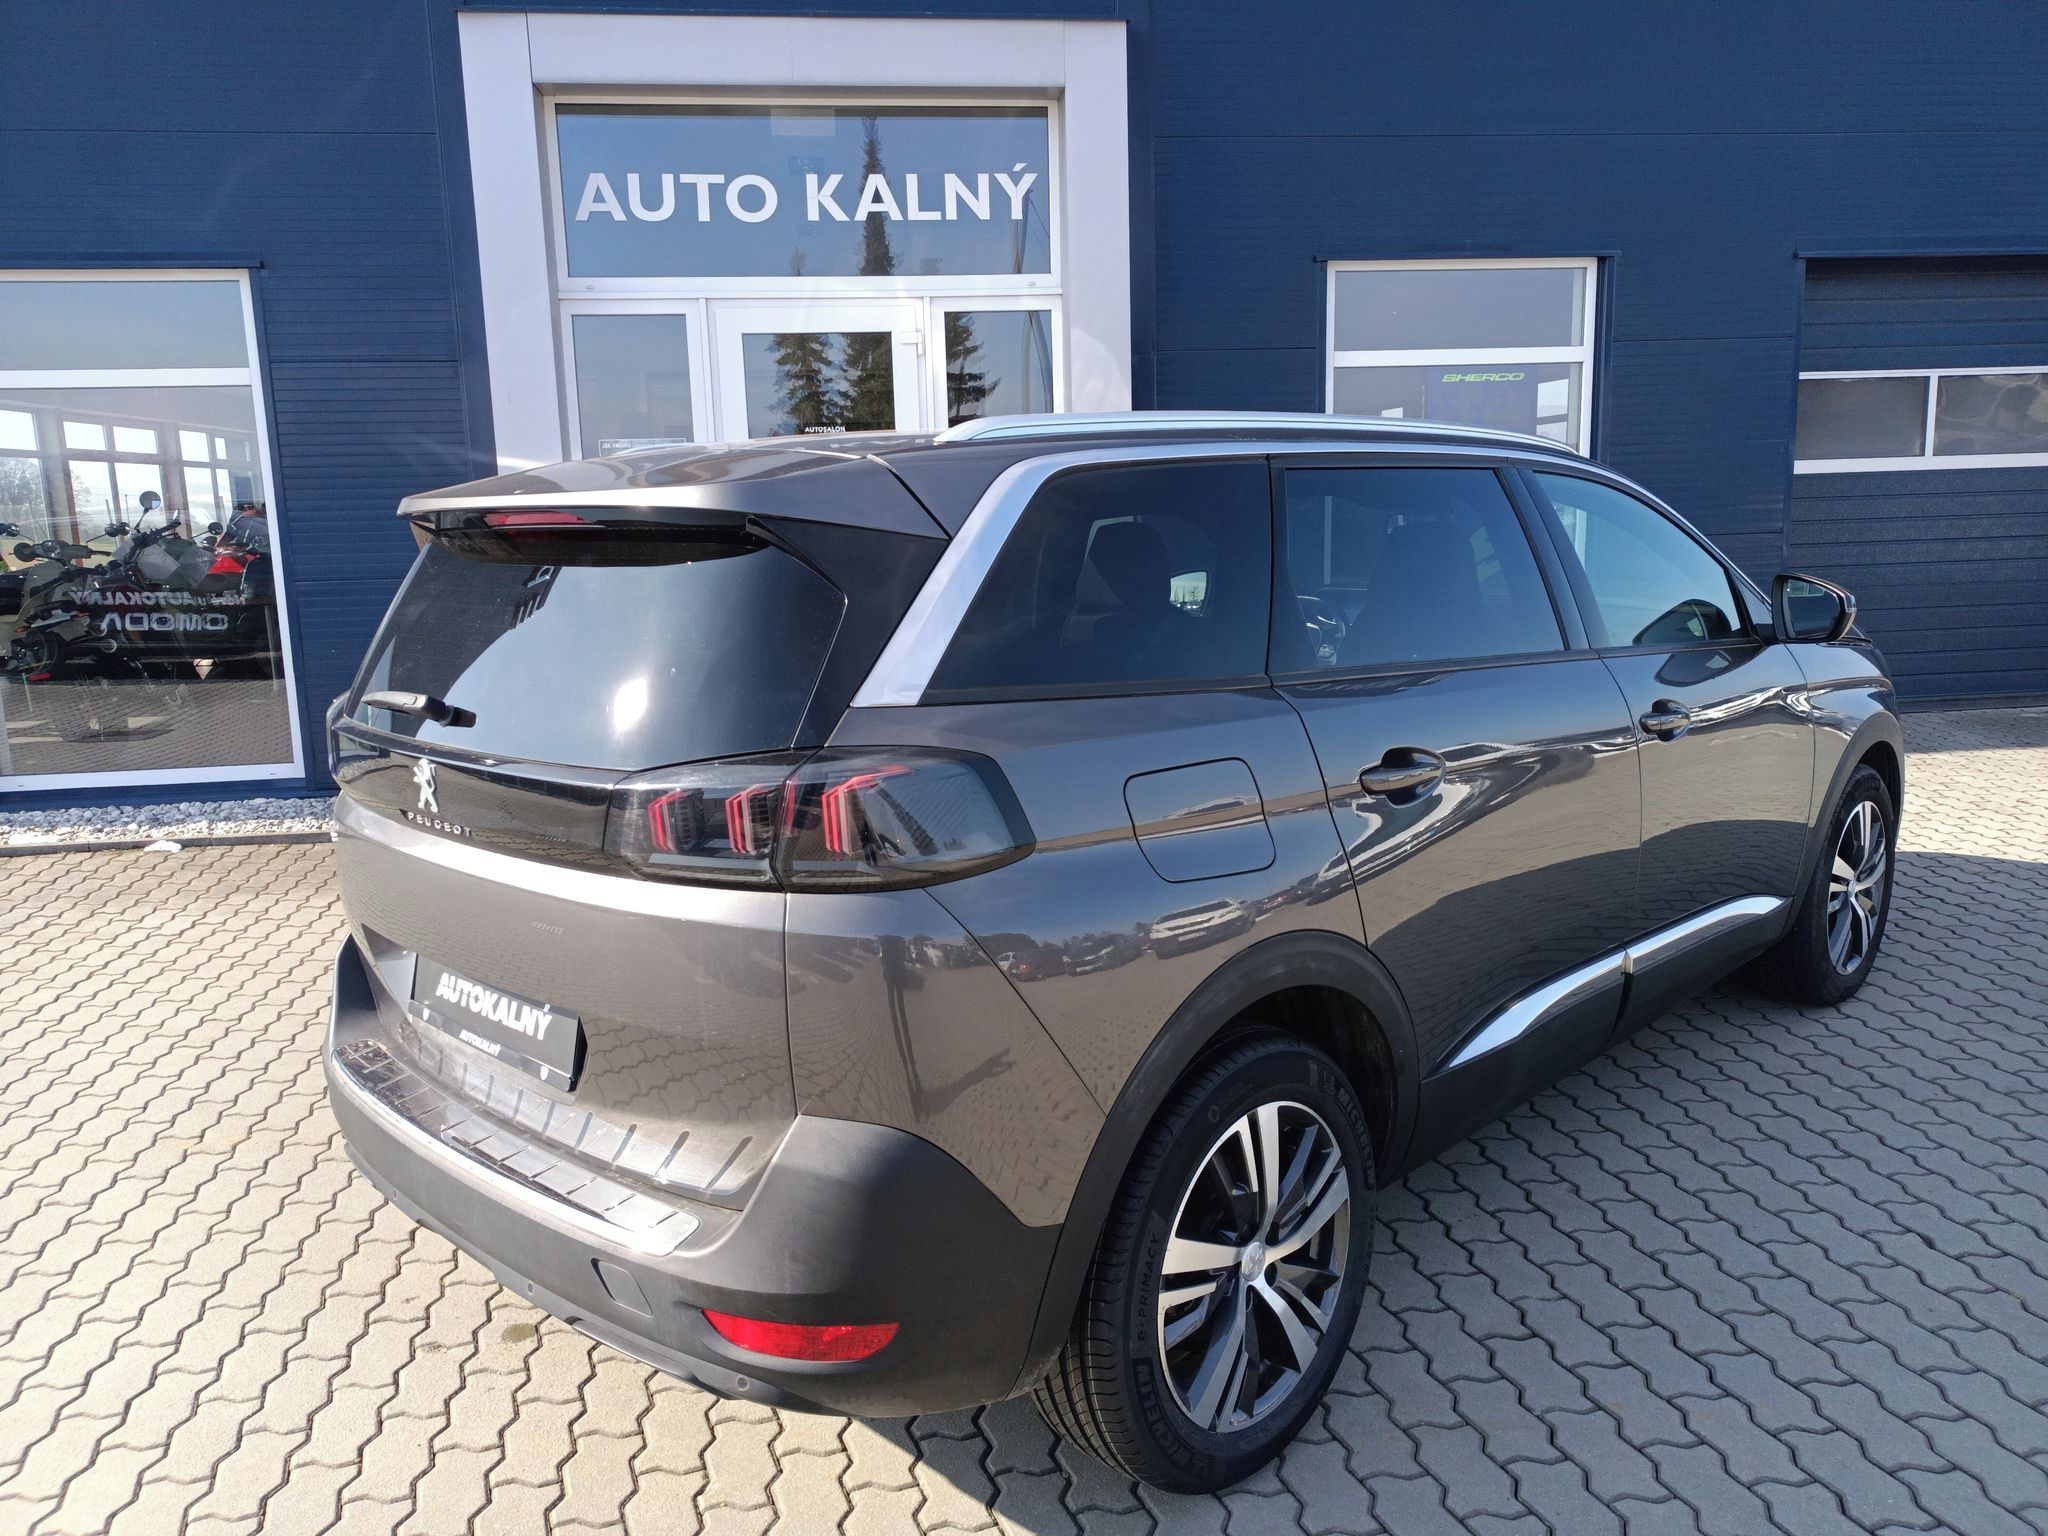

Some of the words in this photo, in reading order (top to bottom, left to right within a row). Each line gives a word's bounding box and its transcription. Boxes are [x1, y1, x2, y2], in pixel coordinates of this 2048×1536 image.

[575, 173, 778, 223] AUTO
[806, 162, 1038, 222] KALNÝ
[1441, 372, 1526, 383] SHERCO
[804, 425, 846, 433] AUTOSALON
[408, 811, 471, 837] PEUGEOT
[436, 972, 553, 1041] AUTOKALNÝ
